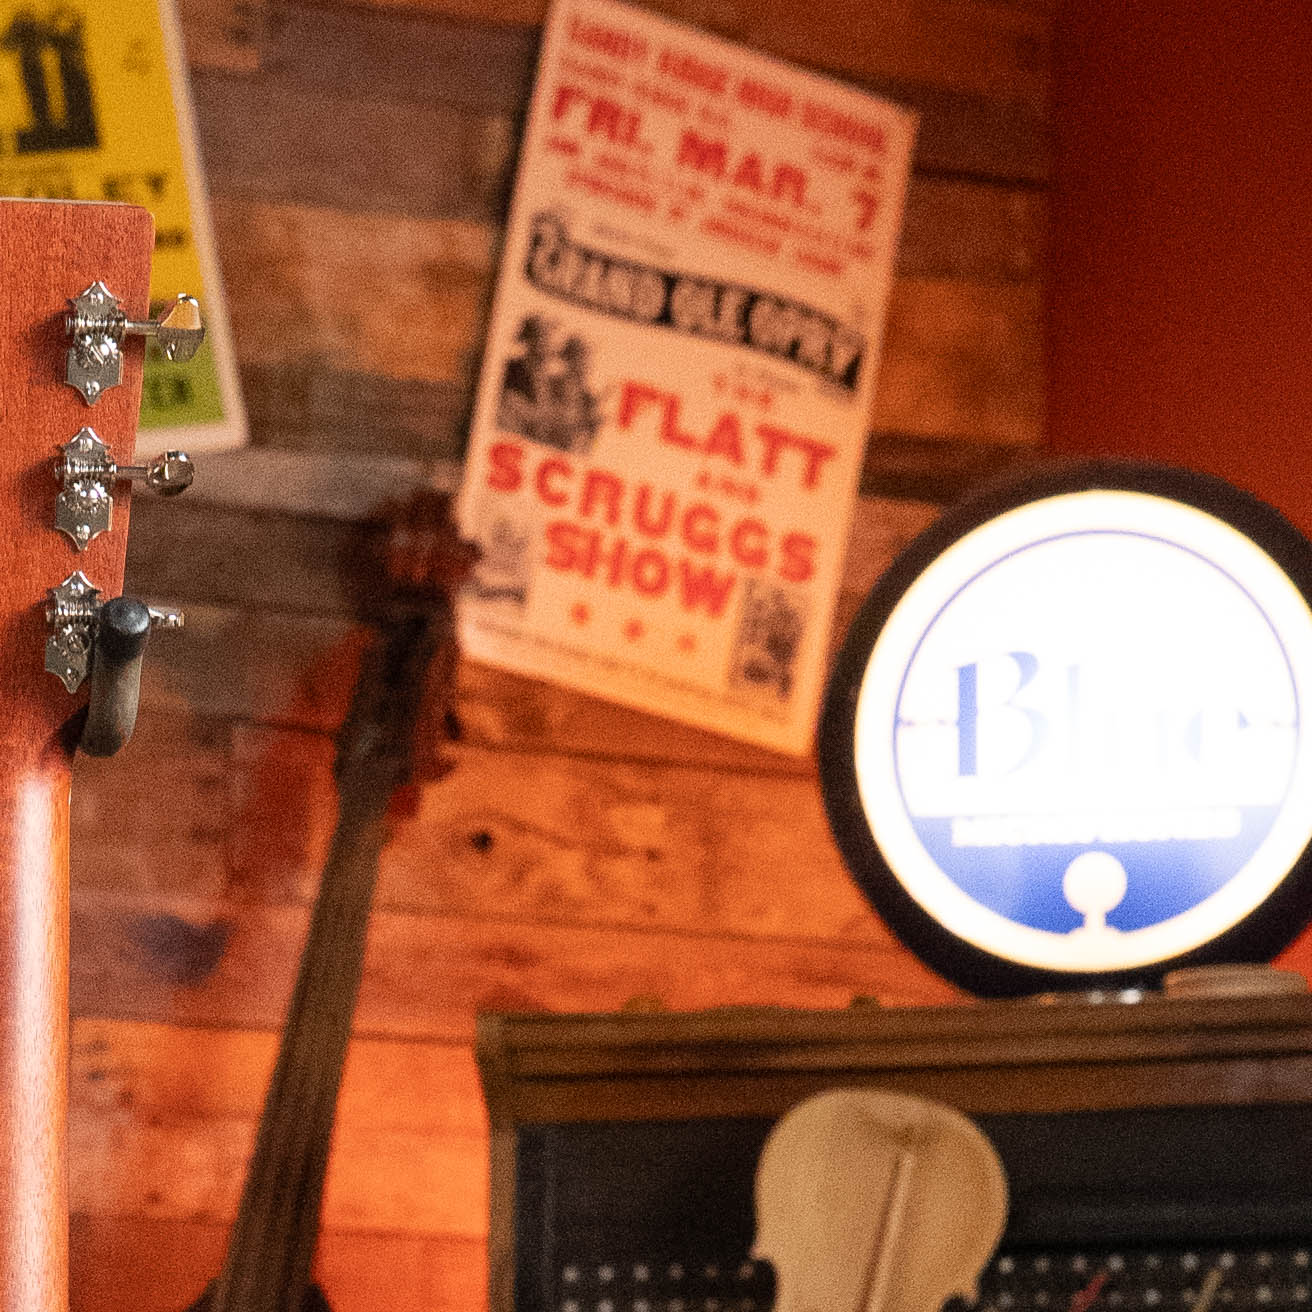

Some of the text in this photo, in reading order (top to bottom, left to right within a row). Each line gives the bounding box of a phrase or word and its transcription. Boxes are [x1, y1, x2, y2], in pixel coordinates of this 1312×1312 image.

[615, 379, 839, 493] FLATT
[486, 440, 817, 584] SCRUGGS
[544, 518, 737, 620] SHOW
